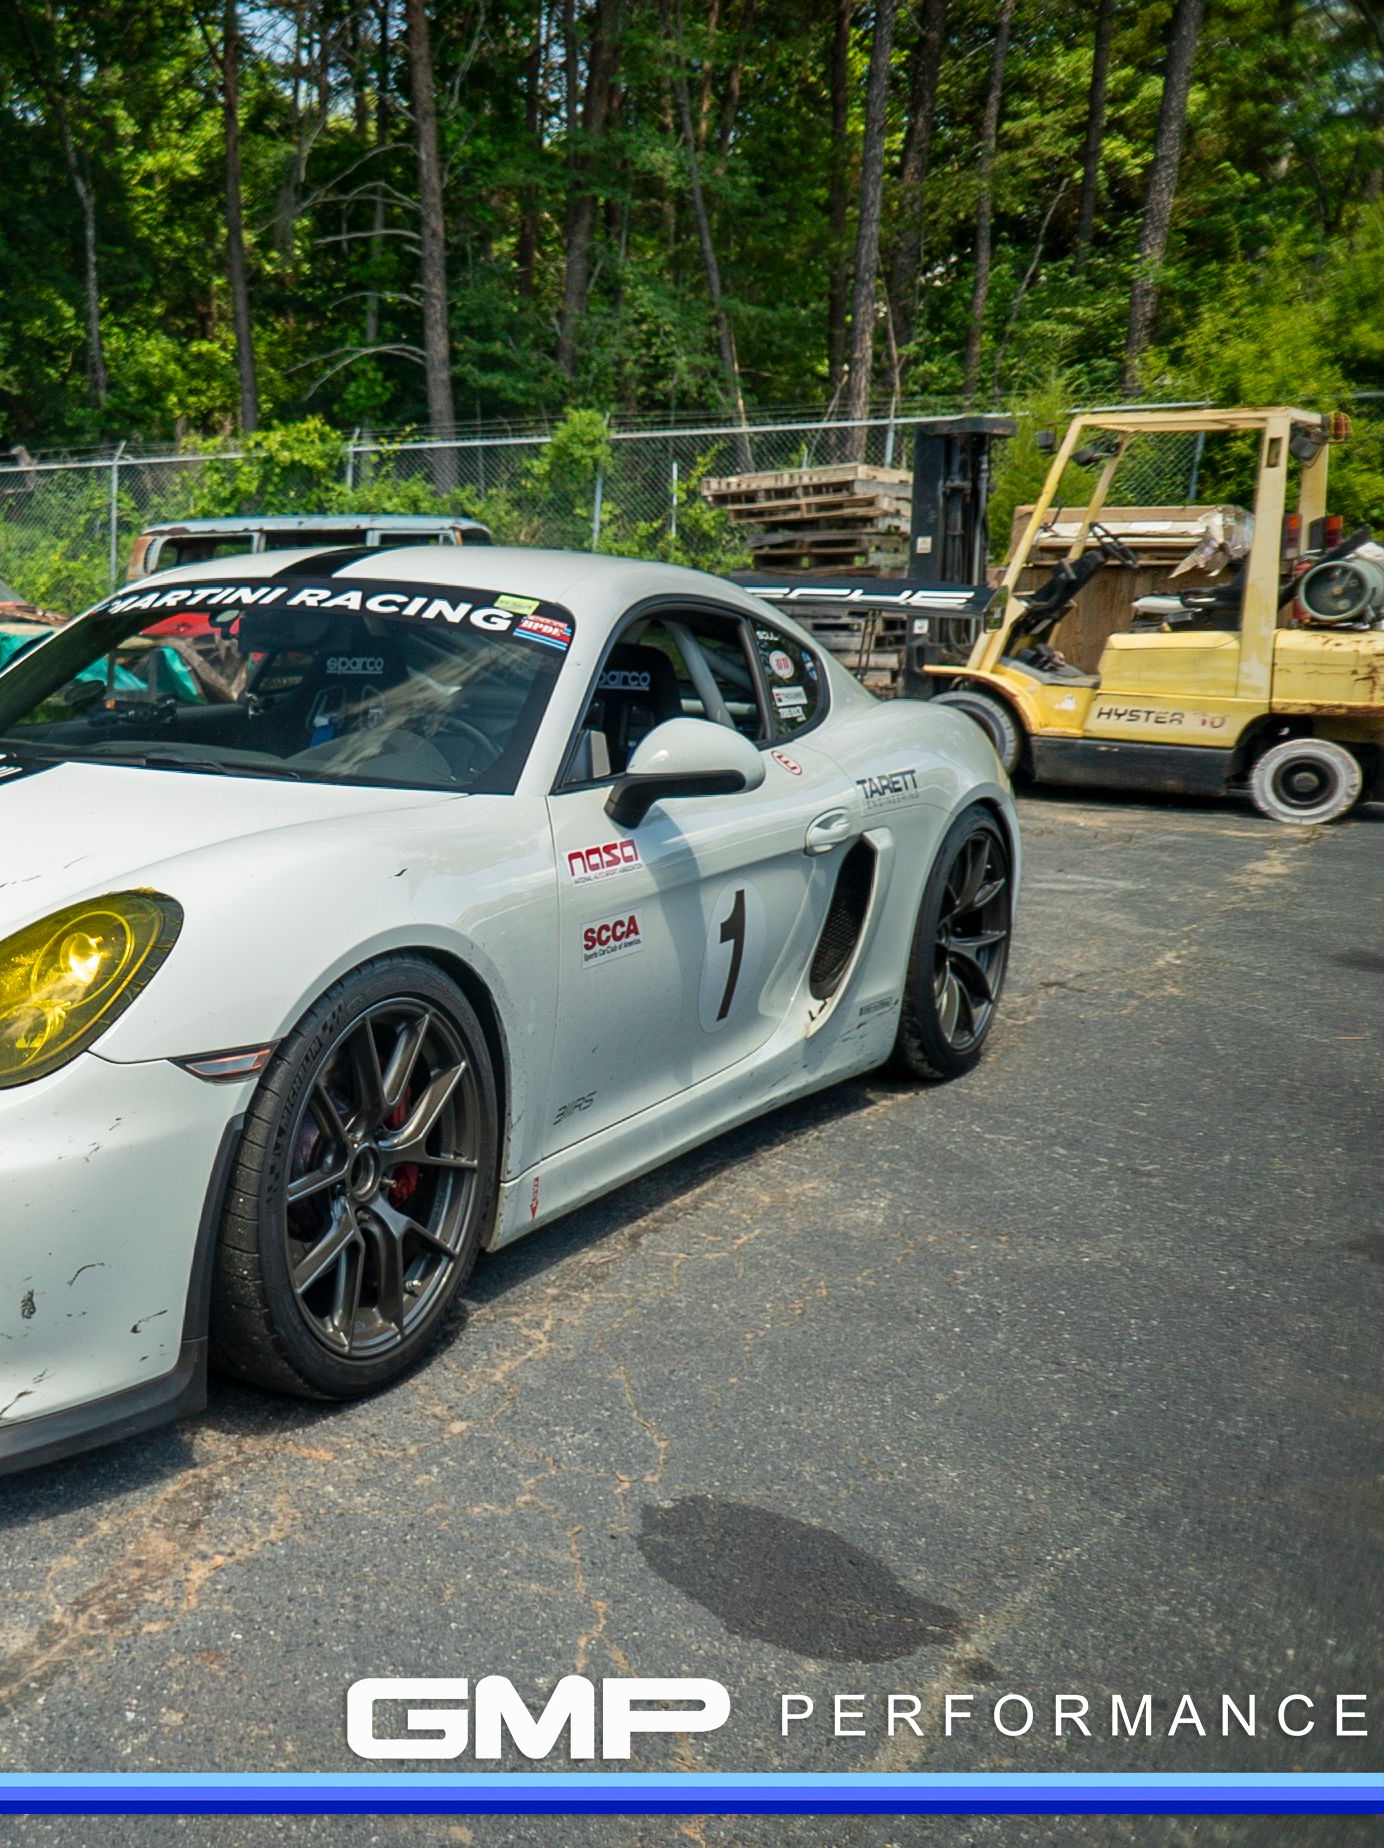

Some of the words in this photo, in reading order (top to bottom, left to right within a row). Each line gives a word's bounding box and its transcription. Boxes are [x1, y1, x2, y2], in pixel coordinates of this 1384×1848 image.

[98, 586, 286, 616] MARTINI
[287, 588, 514, 632] RACING
[326, 656, 384, 675] sparco
[1096, 707, 1185, 726] HYSTER
[856, 769, 917, 799] TARETT
[583, 914, 640, 951] SCCA
[716, 888, 746, 1022] 1
